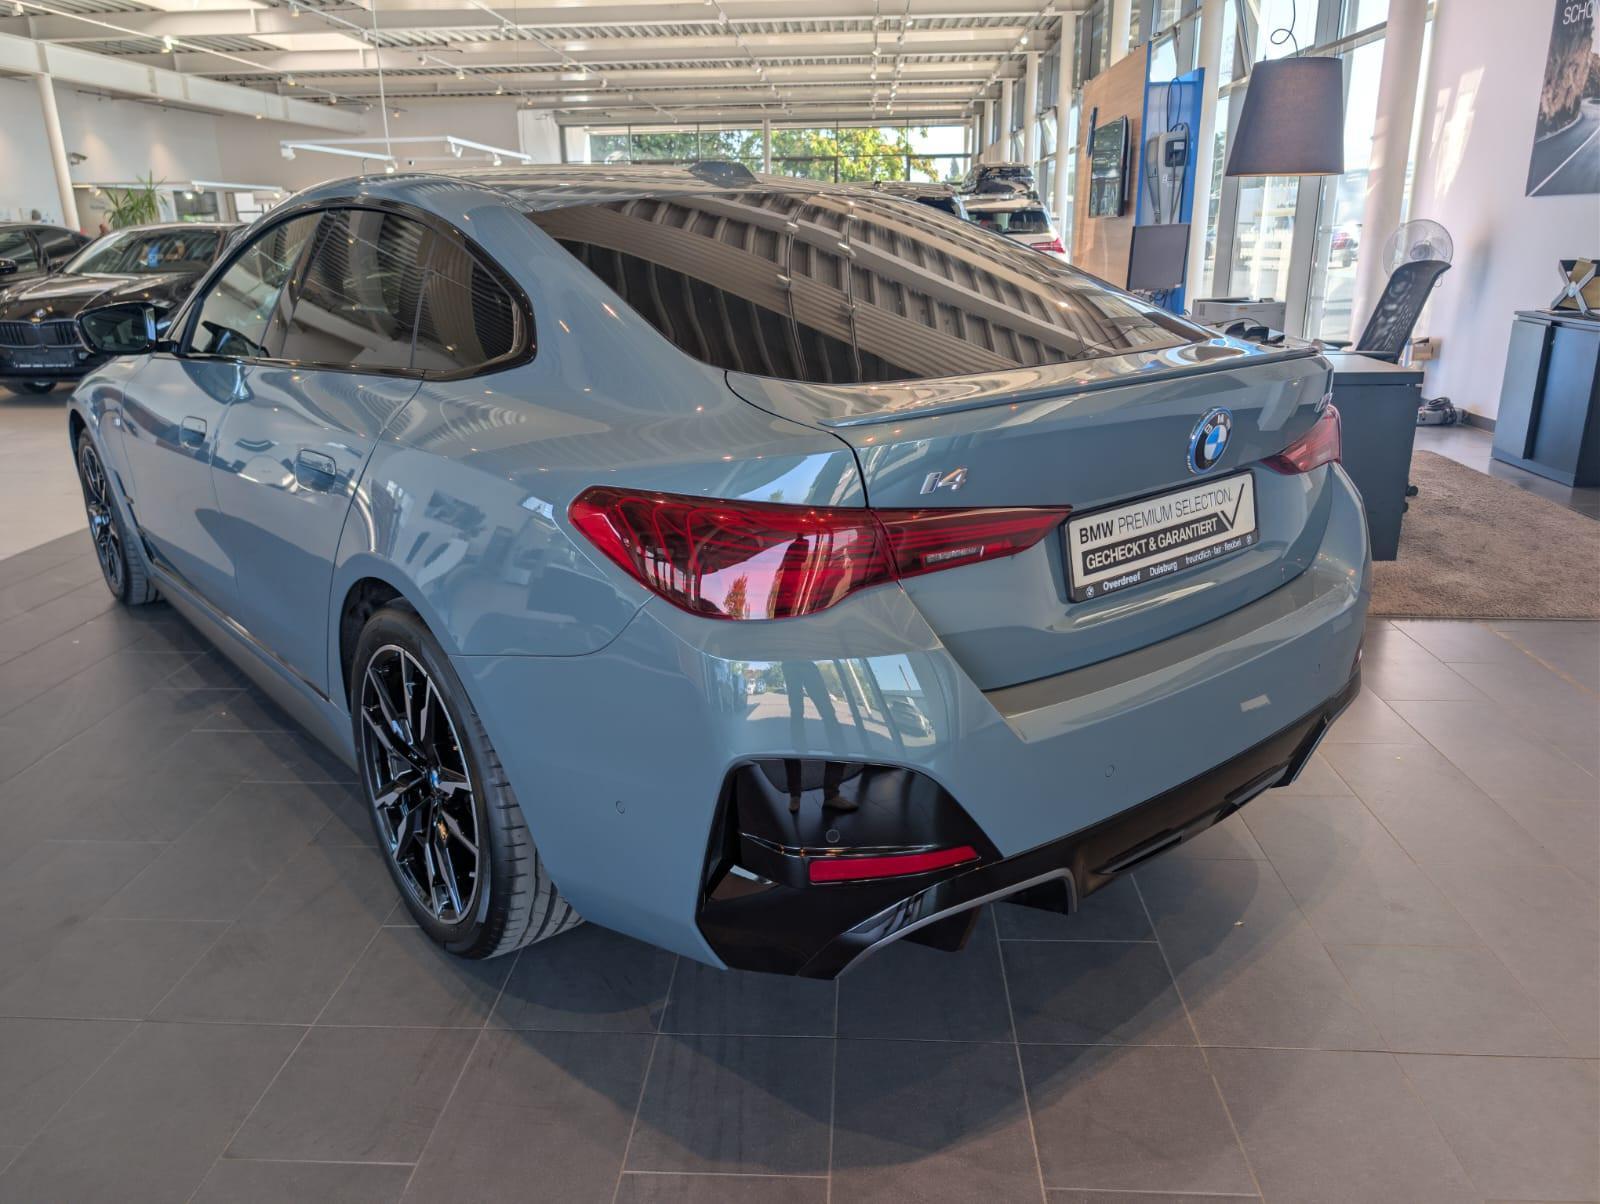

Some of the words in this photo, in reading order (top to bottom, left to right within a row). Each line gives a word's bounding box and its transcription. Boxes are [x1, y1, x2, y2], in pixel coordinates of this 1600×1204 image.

[1079, 519, 1114, 545] BMW
[1118, 506, 1173, 534] PREMIUM
[1085, 538, 1147, 570] GECHECKT
[1148, 534, 1158, 551] &
[1157, 516, 1218, 547] GARANTIERT
[1102, 571, 1142, 592] Overdreef
[1149, 561, 1178, 576] Duisburg
